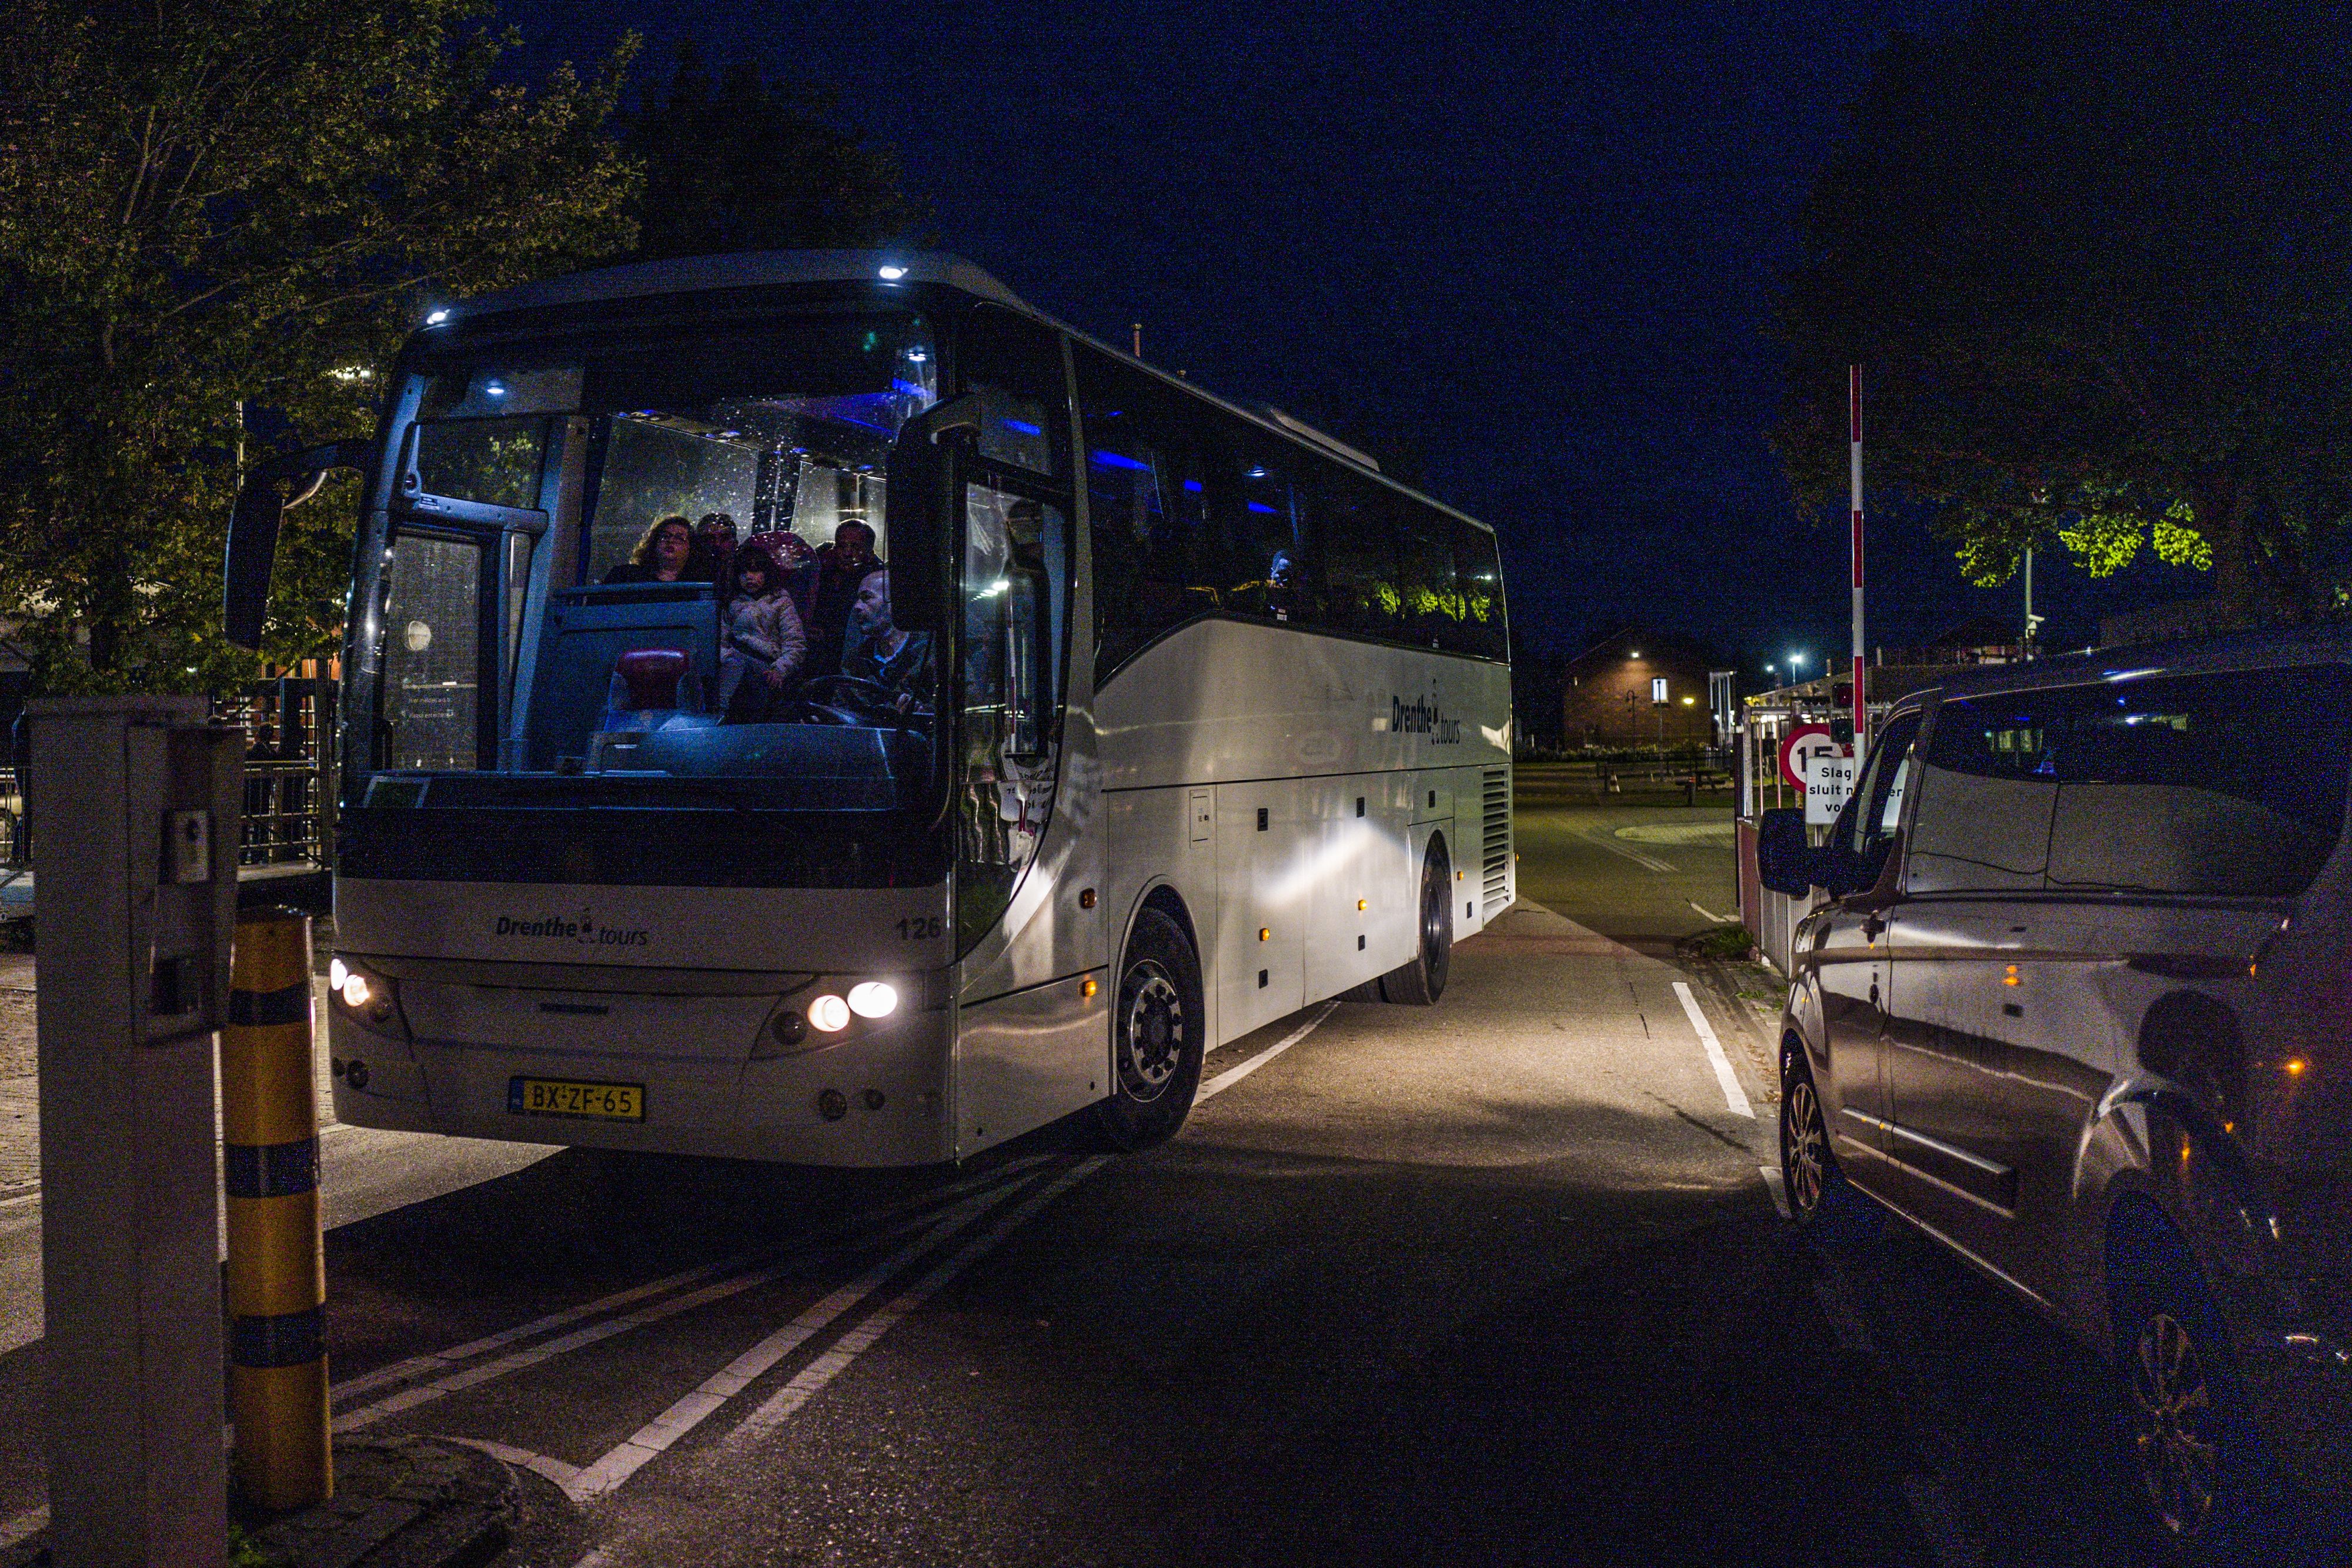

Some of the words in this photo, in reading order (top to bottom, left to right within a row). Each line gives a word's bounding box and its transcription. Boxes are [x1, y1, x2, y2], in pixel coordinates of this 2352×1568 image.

[1392, 694, 1432, 734] Drenthe
[1441, 713, 1460, 744] tours
[1821, 767, 1852, 781] Slag
[1809, 784, 1840, 795] sluit
[497, 916, 577, 937] Drenthe
[600, 927, 647, 945] tours
[896, 917, 940, 940] 126
[533, 1085, 632, 1113] BX-ZF-65
